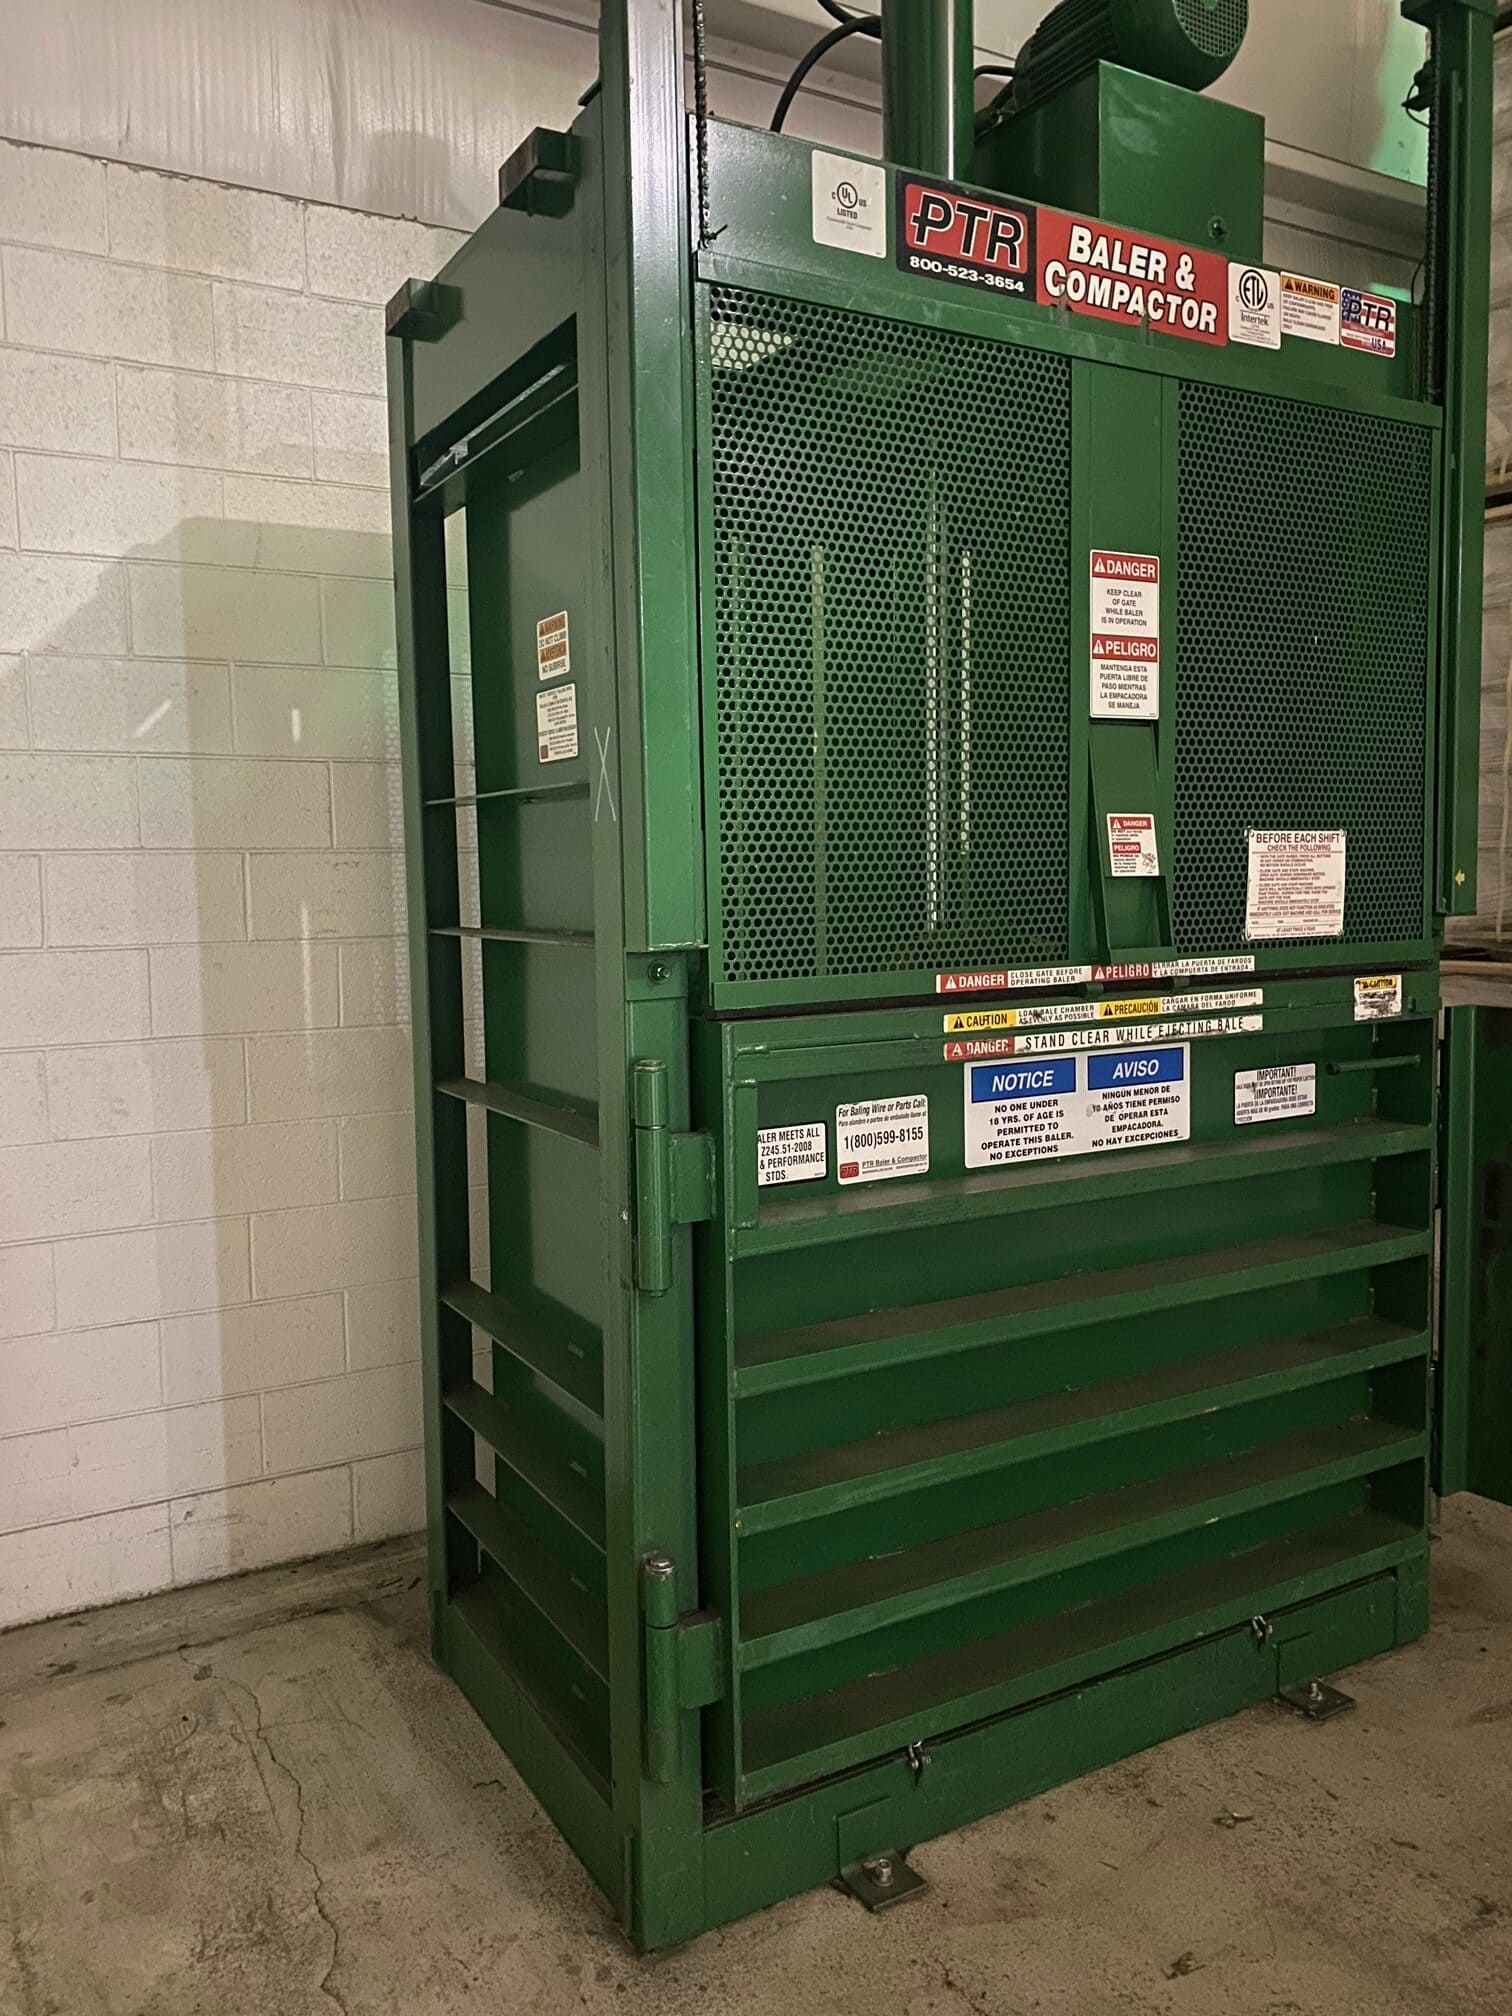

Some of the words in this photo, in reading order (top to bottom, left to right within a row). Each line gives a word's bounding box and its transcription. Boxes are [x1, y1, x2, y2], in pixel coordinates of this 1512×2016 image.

[842, 187, 852, 203] UL
[837, 208, 858, 219] LISTED
[910, 192, 1024, 268] PTR
[1068, 224, 1167, 285] BALER
[1175, 253, 1195, 292] &
[910, 256, 1024, 292] 800-523-3654
[1044, 260, 1217, 334] COMPACTOR
[1295, 281, 1334, 299] WARNING
[1241, 312, 1269, 326] Intertek
[1347, 300, 1391, 332] PTR
[1371, 338, 1387, 351] USA
[1107, 560, 1155, 578] DANGER
[1107, 588, 1122, 596] KEEP
[1123, 590, 1142, 598] CLEAR
[1106, 607, 1122, 615] WHILE
[1124, 609, 1143, 617] BALER
[1116, 618, 1147, 626] OPERATION
[1106, 640, 1156, 657] PELIGRO
[1101, 664, 1132, 672] MANTENGA
[1134, 665, 1147, 673] ESTA
[1256, 833, 1292, 843] BEFORE
[1295, 833, 1316, 843] EACH
[1319, 833, 1339, 842] SHIFT
[1192, 959, 1215, 967] PUERTA
[1011, 970, 1033, 978] CLOSE
[1036, 969, 1052, 977] GATE
[1056, 968, 1082, 976] BEFORE
[1106, 964, 1149, 978] PELIGRO
[1170, 967, 1208, 975] COMPUERTA
[959, 974, 1005, 988] DANGER
[1011, 977, 1050, 986] OPERATING
[1162, 996, 1188, 1004] CARGAR
[1201, 994, 1223, 1002] FORMA
[1225, 991, 1256, 999] UNIFORME
[1061, 1005, 1094, 1013] CHAMBER
[1115, 1001, 1158, 1015] PRECAUCIÓN
[967, 1014, 1007, 1027] CAUTION
[1065, 1012, 1094, 1020] POSSIBLE
[1026, 1034, 1064, 1049] STAND
[1072, 1030, 1109, 1045] CLEAR
[1116, 1026, 1154, 1041] WHILE
[1159, 1020, 1211, 1037] EJECTING
[1218, 1017, 1243, 1031] BALE
[967, 1039, 1008, 1054] DANGER
[1113, 1059, 1159, 1079] AVISO
[1257, 1067, 1296, 1080] IMPORTANT!
[992, 1070, 1054, 1092] NOTICE
[1102, 1088, 1131, 1100] NINGÚN
[1134, 1086, 1159, 1096] MENOR
[1161, 1085, 1170, 1093] DE
[839, 1108, 849, 1117] For
[851, 1105, 870, 1116] Baling
[872, 1103, 886, 1113] Wire
[896, 1101, 911, 1110] Parts
[995, 1105, 1007, 1113] NO
[1010, 1102, 1027, 1111] ONE
[1030, 1099, 1058, 1109] UNDER
[1103, 1101, 1123, 1111] AÑOS
[1126, 1099, 1146, 1108] TIENE
[1149, 1096, 1180, 1106] PERMISO
[1002, 1115, 1021, 1124] YRS.
[1037, 1111, 1053, 1120] AGE
[1119, 1111, 1148, 1120] OPERAR
[1150, 1108, 1168, 1116] ESTA
[779, 1129, 804, 1141] MEETS
[807, 1128, 820, 1138] ALL
[997, 1123, 1045, 1136] PERMITTED
[1048, 1122, 1058, 1130] TO
[844, 1126, 923, 1152] 1(800)599-8155
[982, 1138, 1020, 1150] OPERATE
[1023, 1135, 1042, 1145] THIS
[1045, 1132, 1074, 1142] BALER.
[1092, 1139, 1103, 1147] NO
[1106, 1137, 1122, 1145] HAY
[1125, 1129, 1178, 1143] EXCEPCIONES
[761, 1141, 812, 1156] Z245.51-2008
[990, 1152, 1002, 1160] NO
[1005, 1145, 1058, 1158] EXCEPTIONS
[760, 1160, 765, 1169] &
[768, 1152, 824, 1168] PERFORMANCE
[862, 1160, 874, 1168] PTR
[897, 1154, 927, 1163] Compactor
